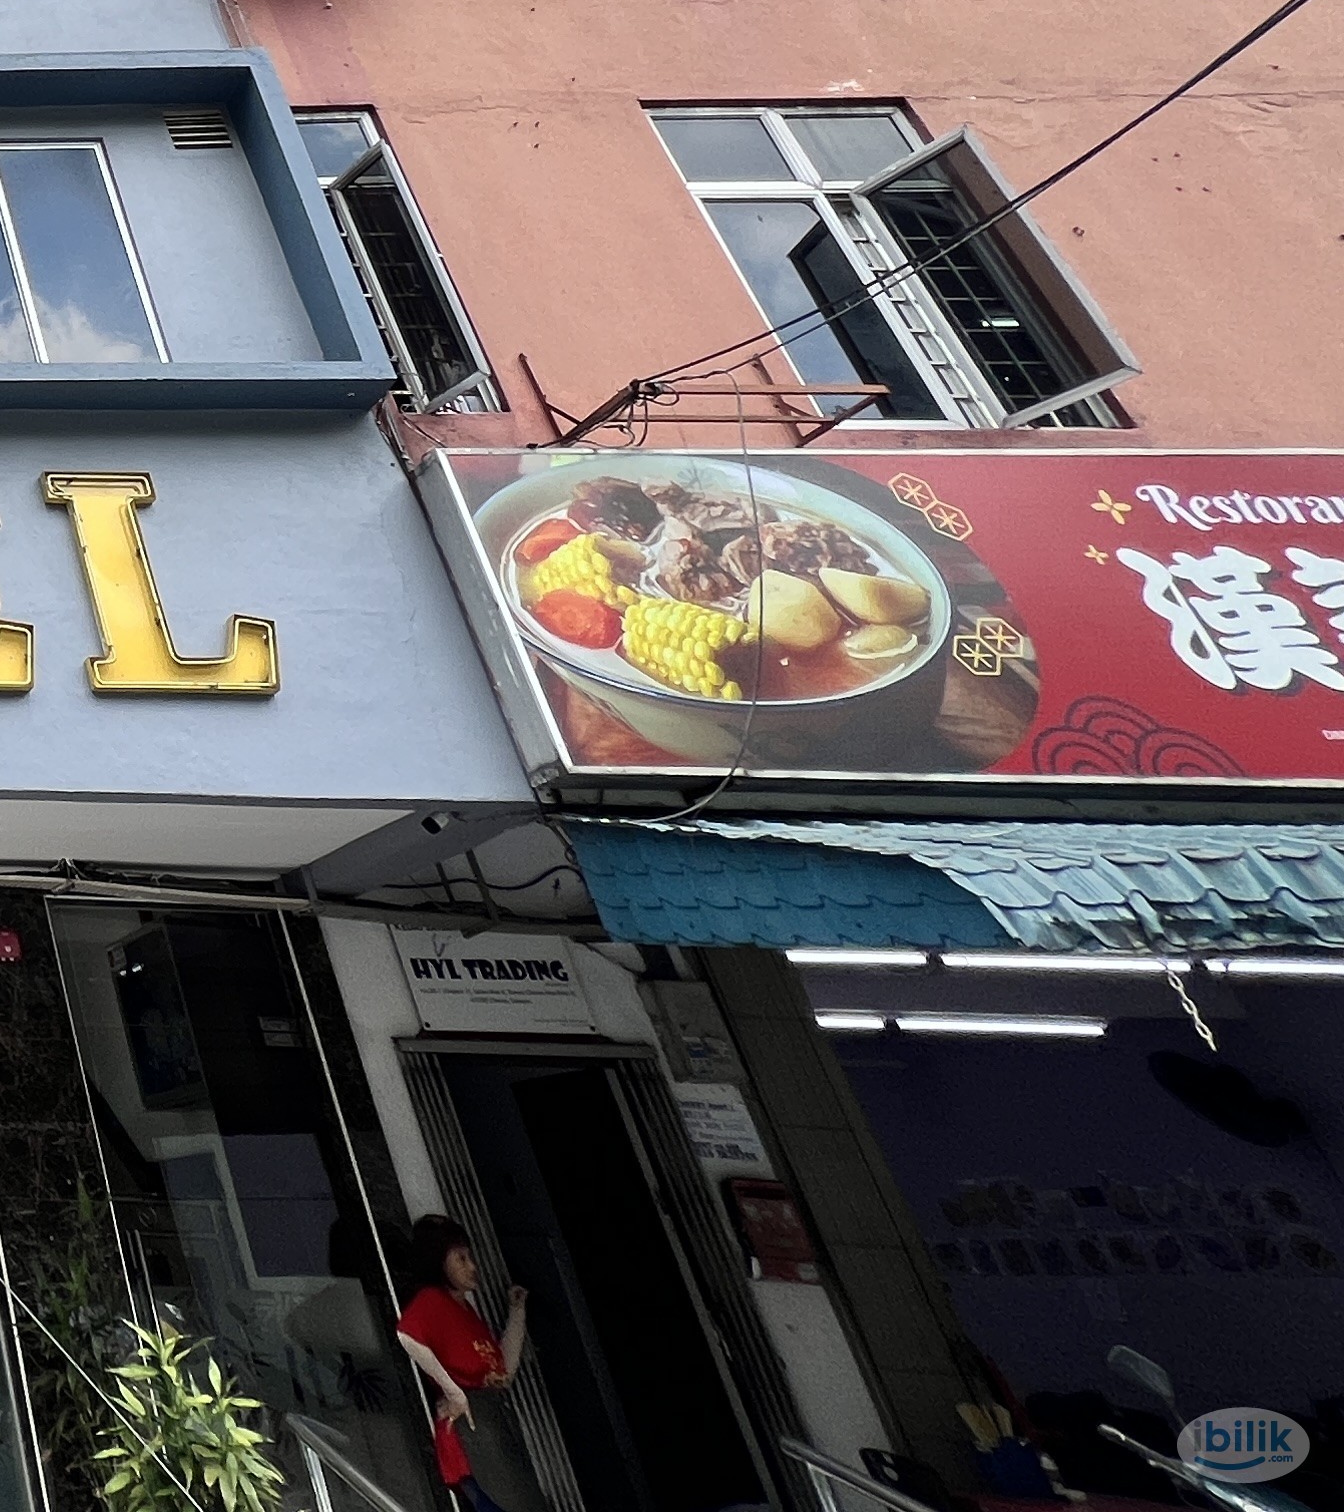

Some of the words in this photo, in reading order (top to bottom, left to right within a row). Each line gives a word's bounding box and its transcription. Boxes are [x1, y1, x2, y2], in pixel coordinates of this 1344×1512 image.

[1135, 484, 1344, 531] Restora
[410, 958, 461, 980] HYL
[461, 958, 569, 982] TRADING
